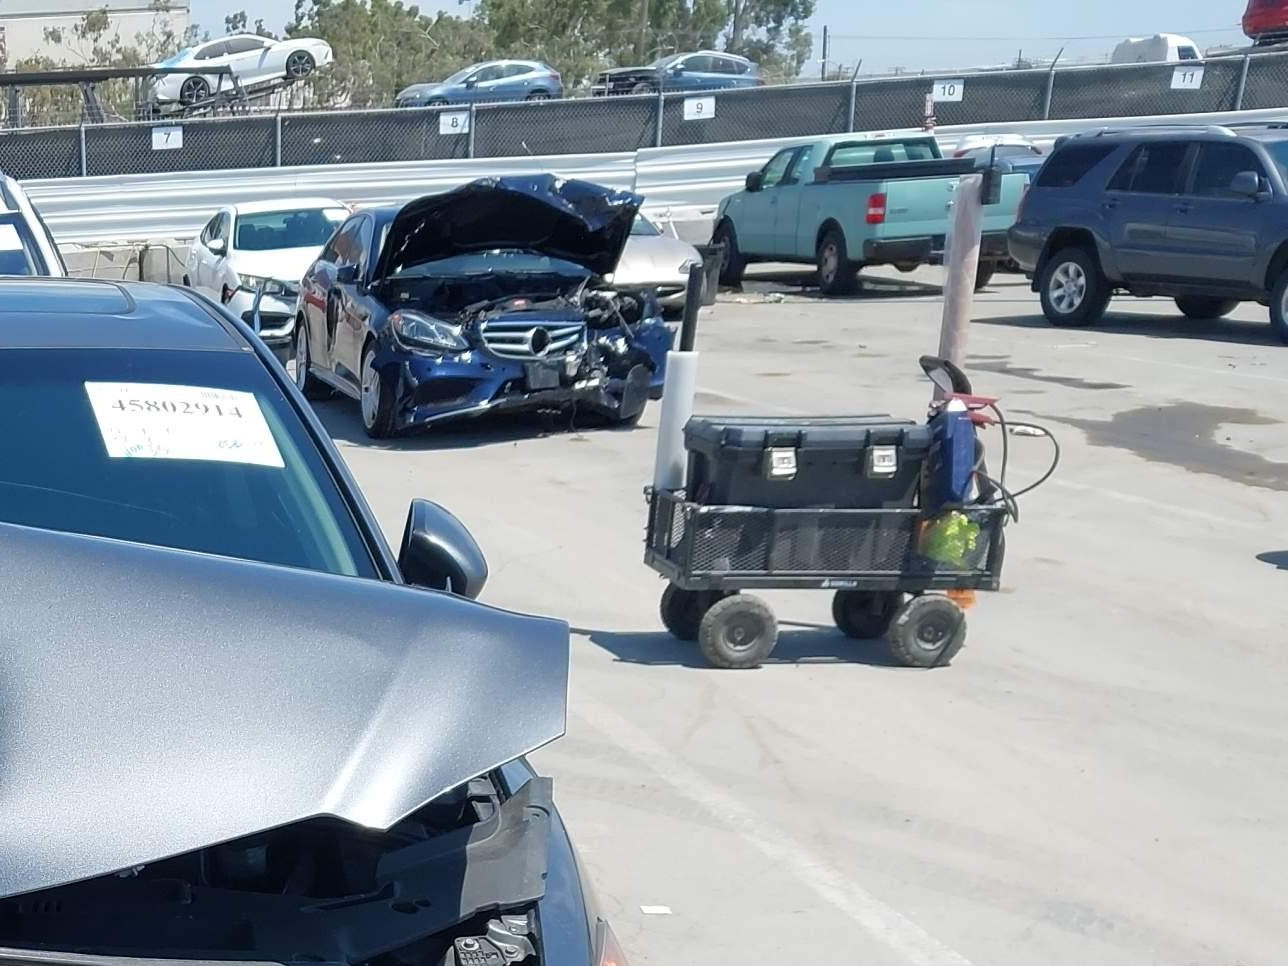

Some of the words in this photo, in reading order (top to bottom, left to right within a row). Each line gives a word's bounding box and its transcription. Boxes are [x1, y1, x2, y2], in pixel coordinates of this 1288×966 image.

[1182, 71, 1195, 83] 11
[941, 84, 956, 96] 10
[696, 102, 703, 114] 9
[451, 117, 459, 128] 8
[163, 132, 171, 144] 7
[112, 399, 244, 418] 45802914
